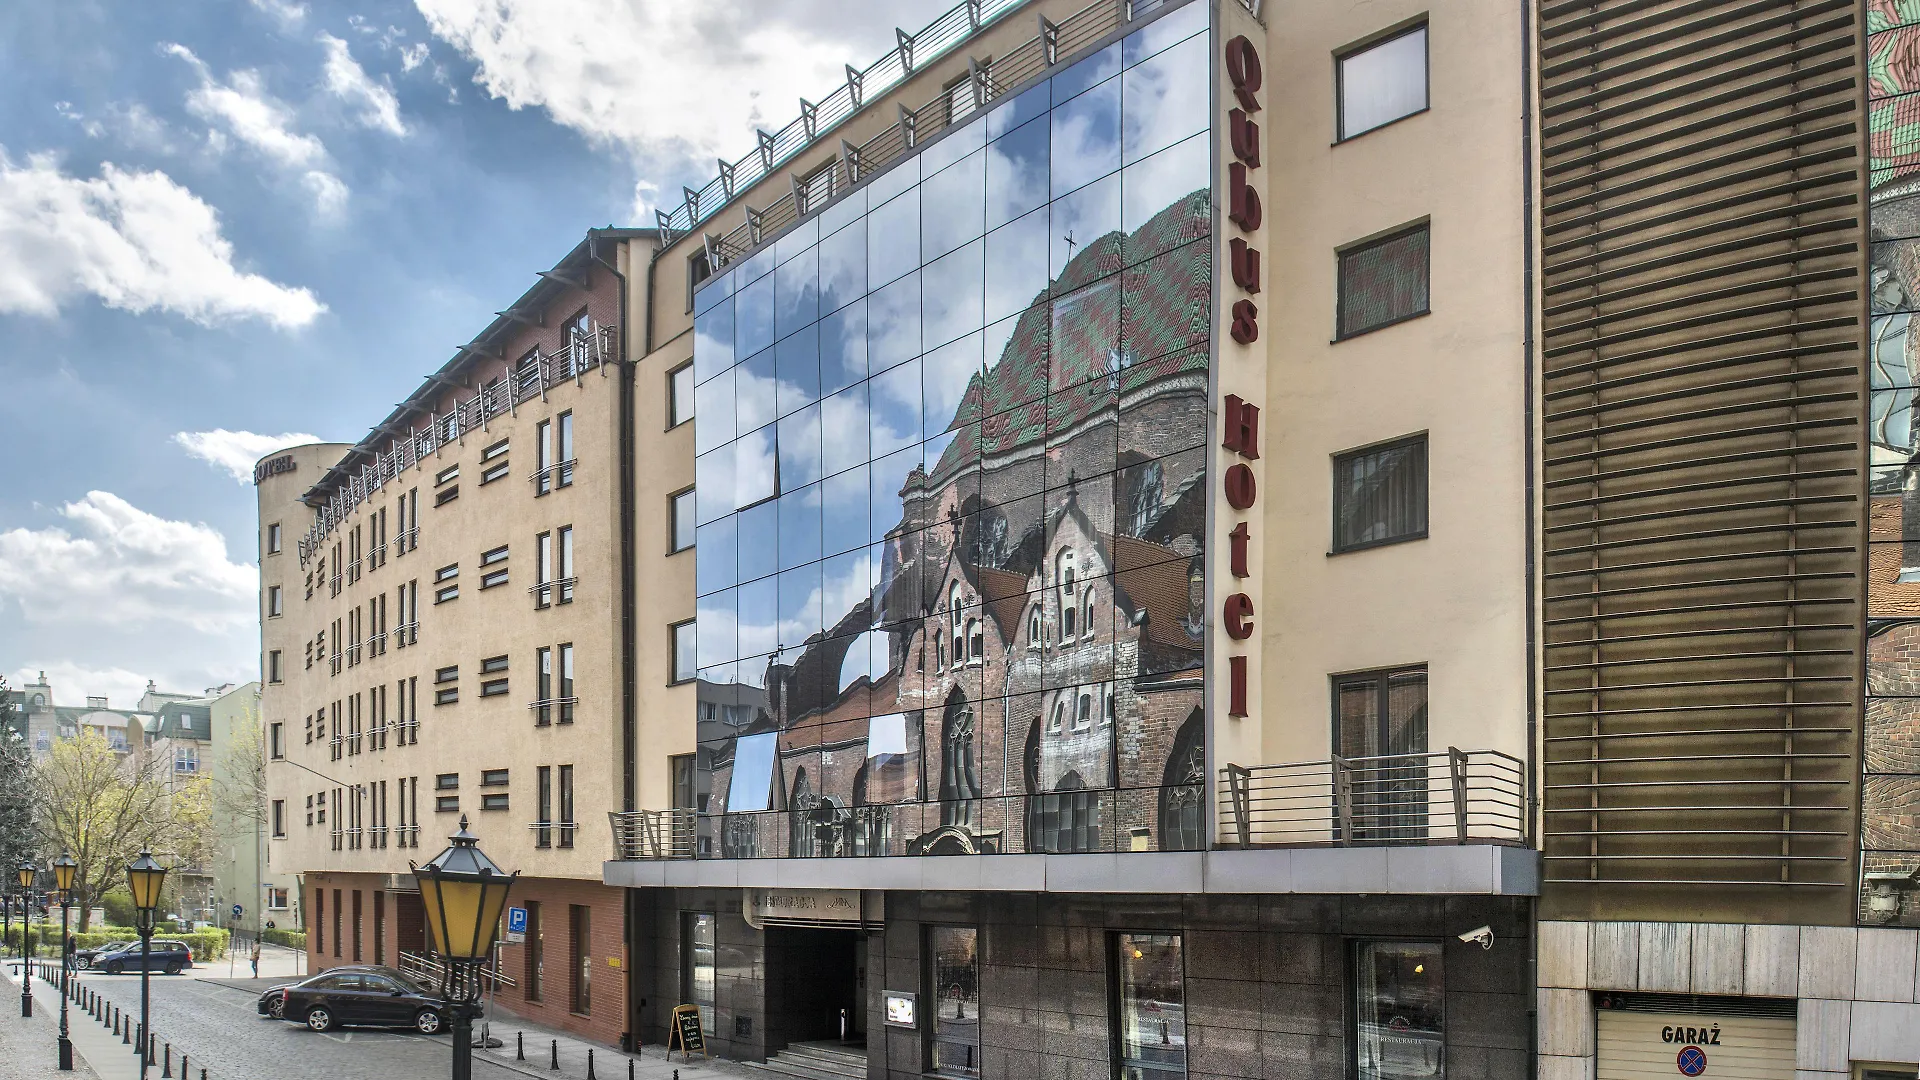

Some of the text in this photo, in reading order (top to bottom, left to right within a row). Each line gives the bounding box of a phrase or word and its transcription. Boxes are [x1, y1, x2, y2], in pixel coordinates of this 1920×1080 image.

[1221, 34, 1262, 718] Qubus Hotel
[513, 910, 523, 925] P
[1661, 1022, 1721, 1046] GARAŻ
